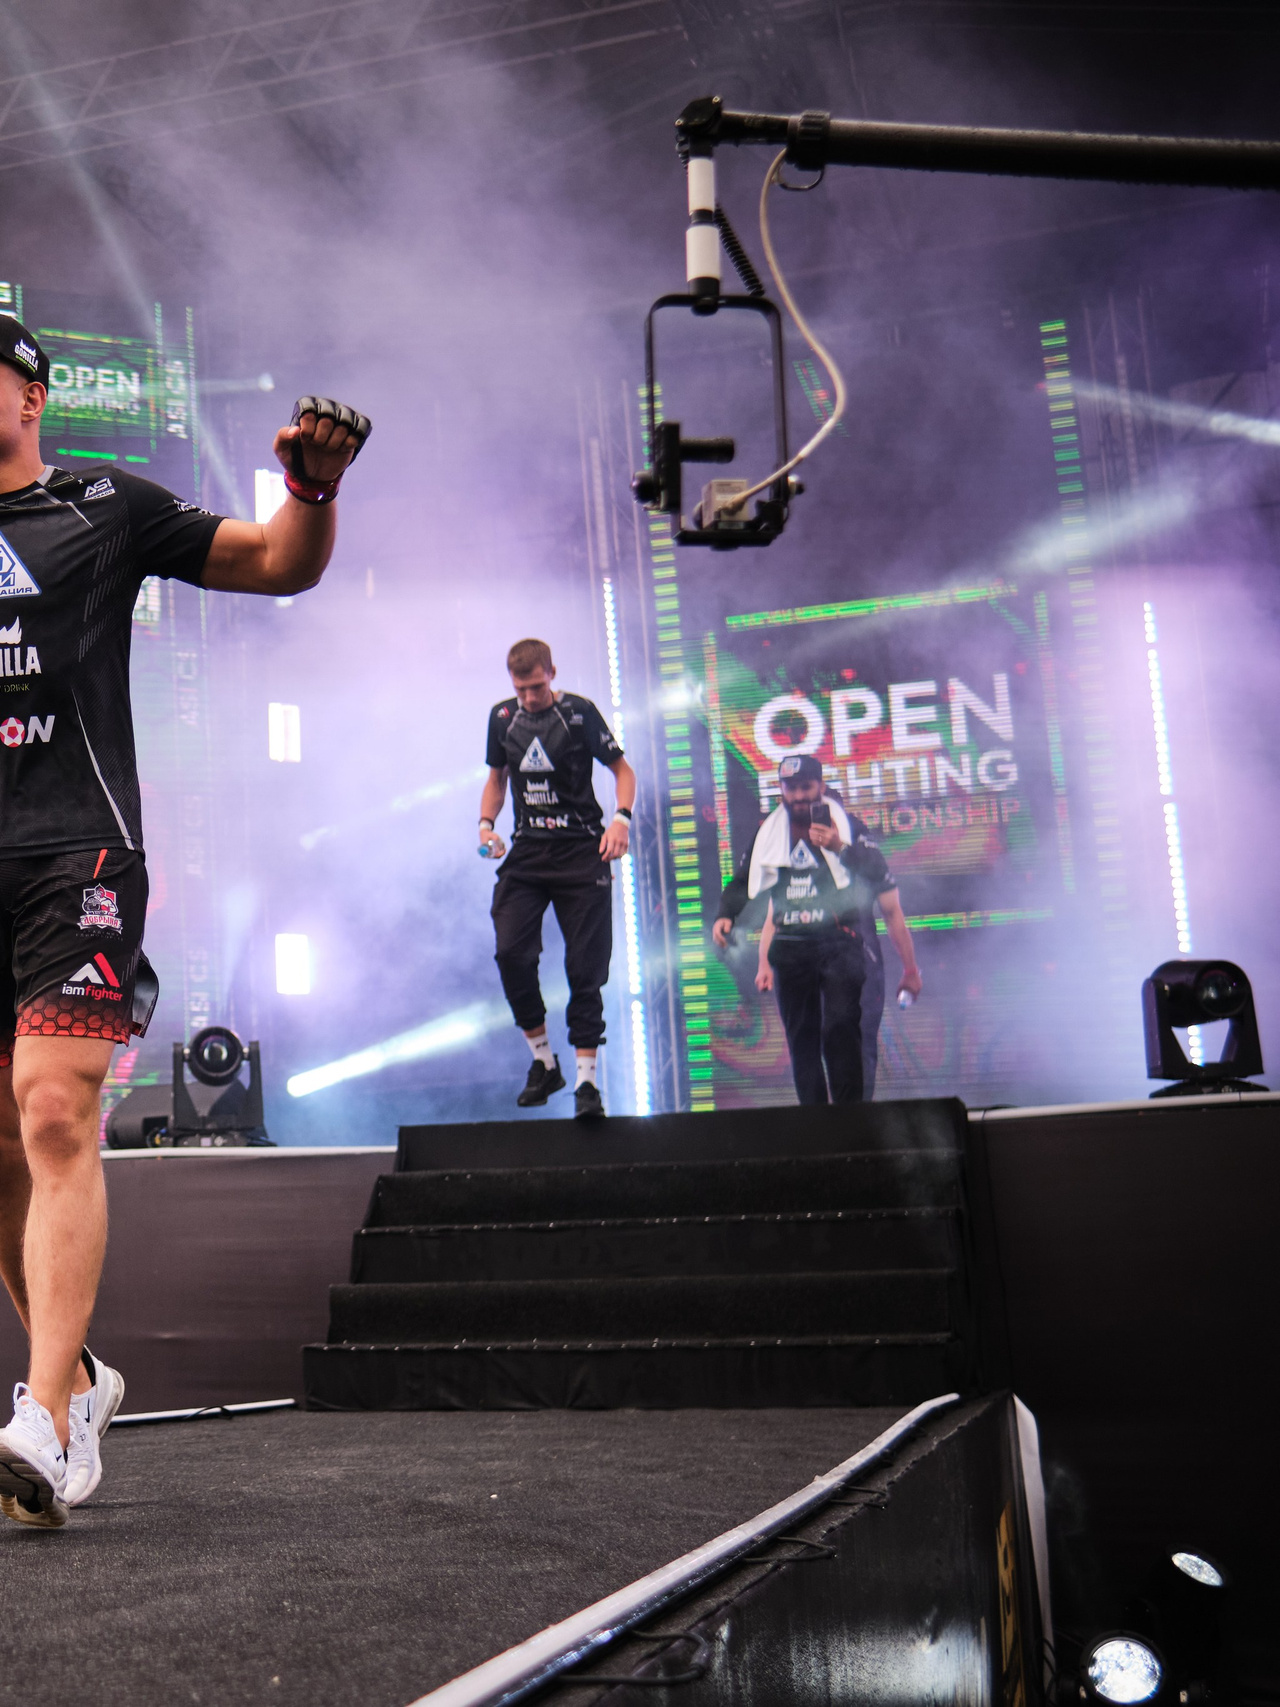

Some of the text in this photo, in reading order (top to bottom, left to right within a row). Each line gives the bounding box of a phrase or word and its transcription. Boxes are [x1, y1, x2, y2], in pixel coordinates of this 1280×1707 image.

[14, 344, 39, 371] GORILLA
[49, 362, 140, 400] OPEN
[83, 477, 113, 498] ASI
[4, 682, 30, 693] DRINK
[753, 673, 1014, 764] OPEN
[758, 750, 1019, 814] FHTING
[528, 814, 569, 829] LEON
[783, 908, 824, 926] LEON
[61, 982, 124, 1002] iamfighter
